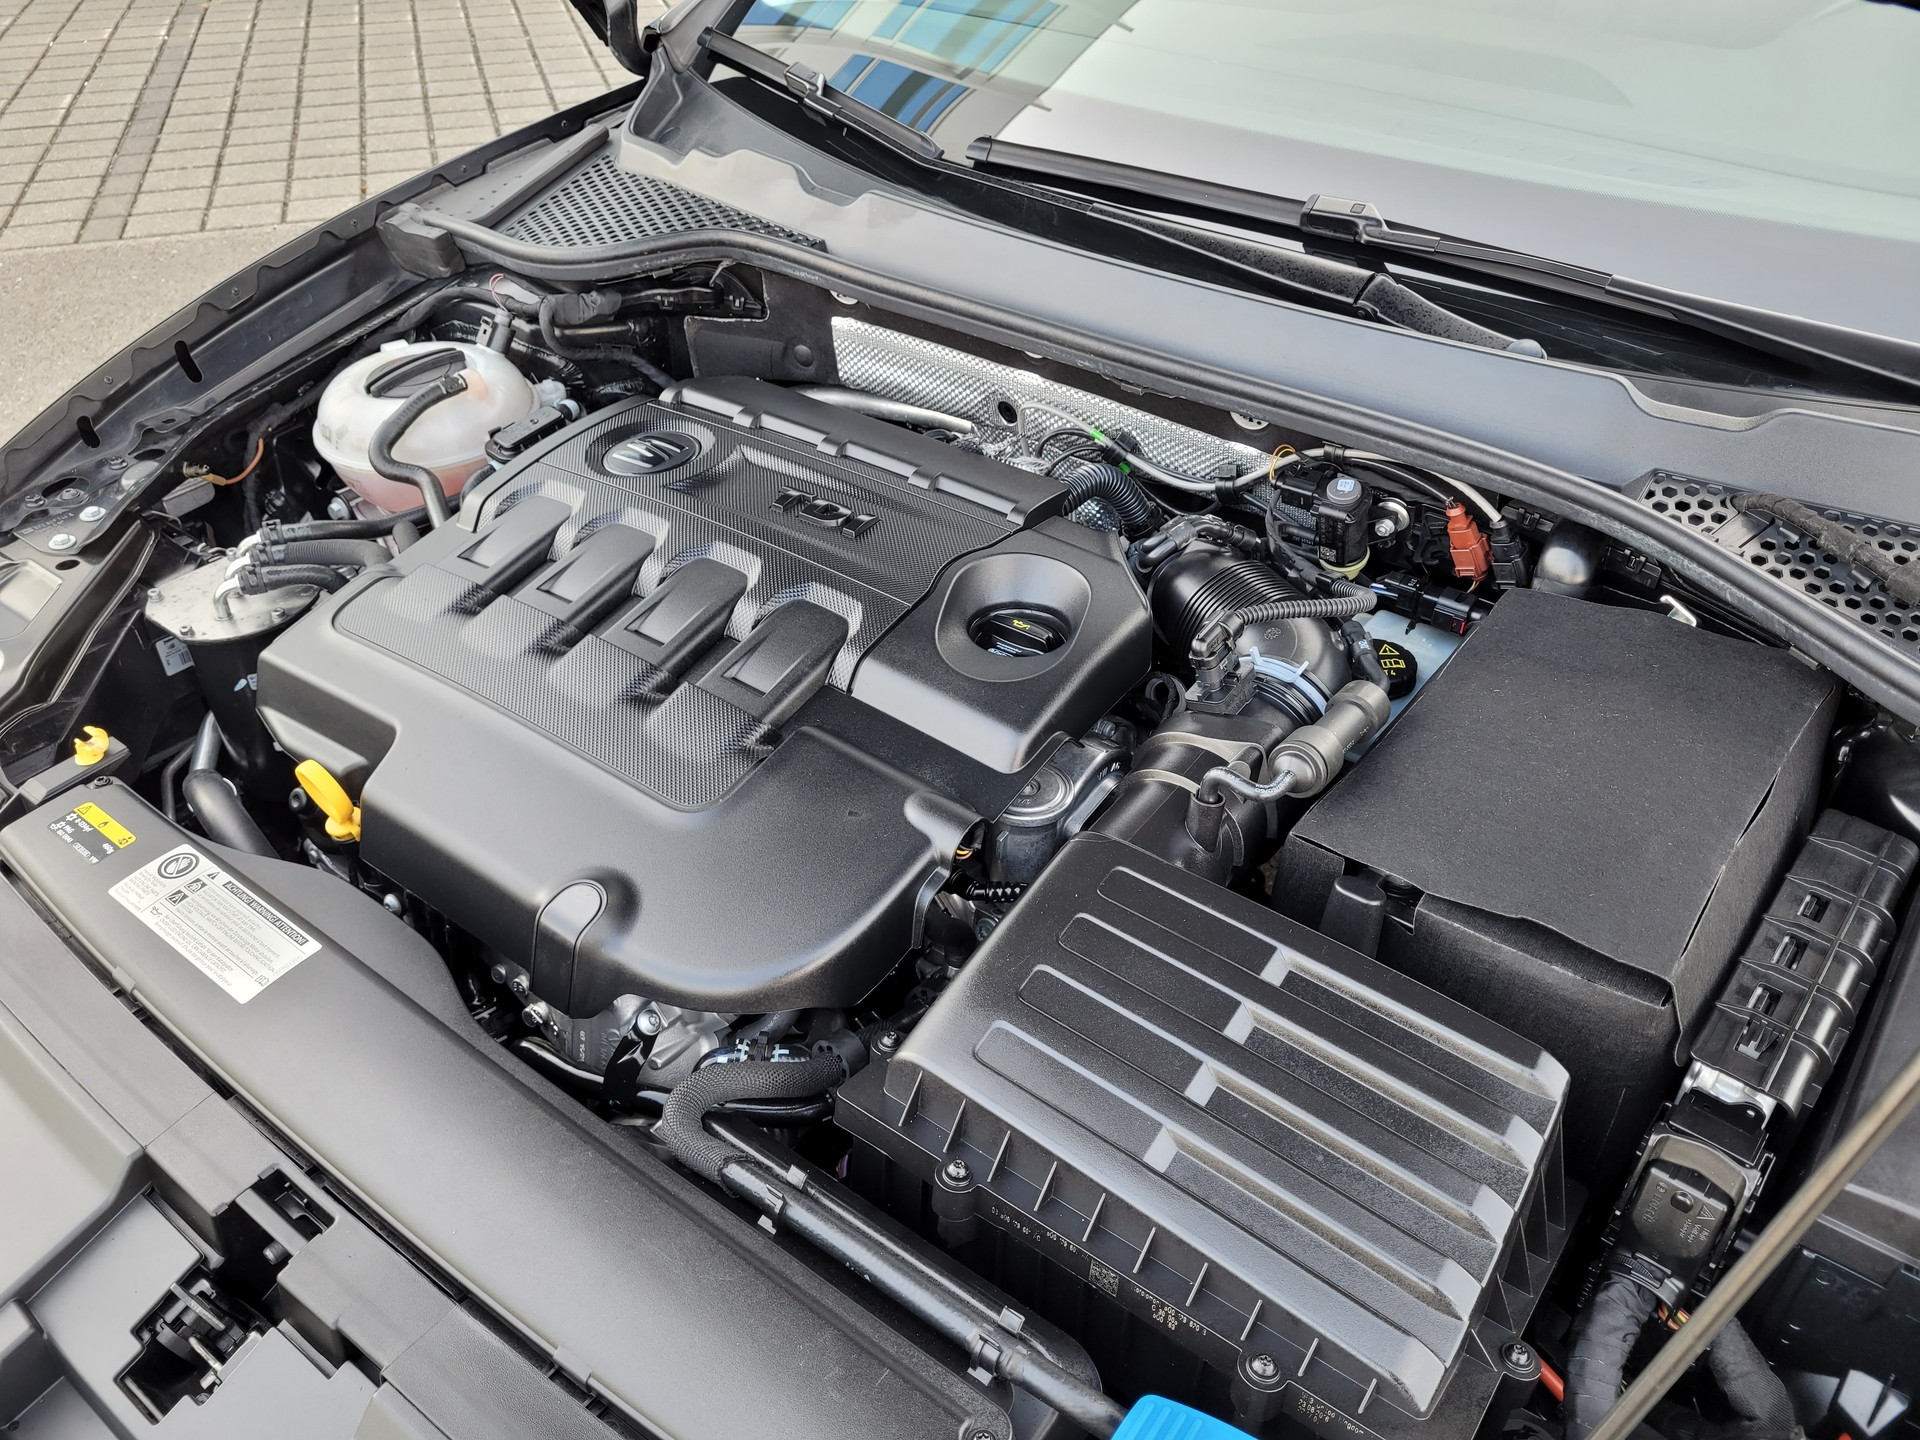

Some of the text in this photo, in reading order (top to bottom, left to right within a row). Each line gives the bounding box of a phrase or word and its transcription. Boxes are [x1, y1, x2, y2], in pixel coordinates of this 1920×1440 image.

[769, 486, 882, 539] TDI
[223, 882, 252, 903] ACHTUNG!
[248, 901, 276, 923] WARNING!
[272, 920, 306, 945] ATTENTION!
